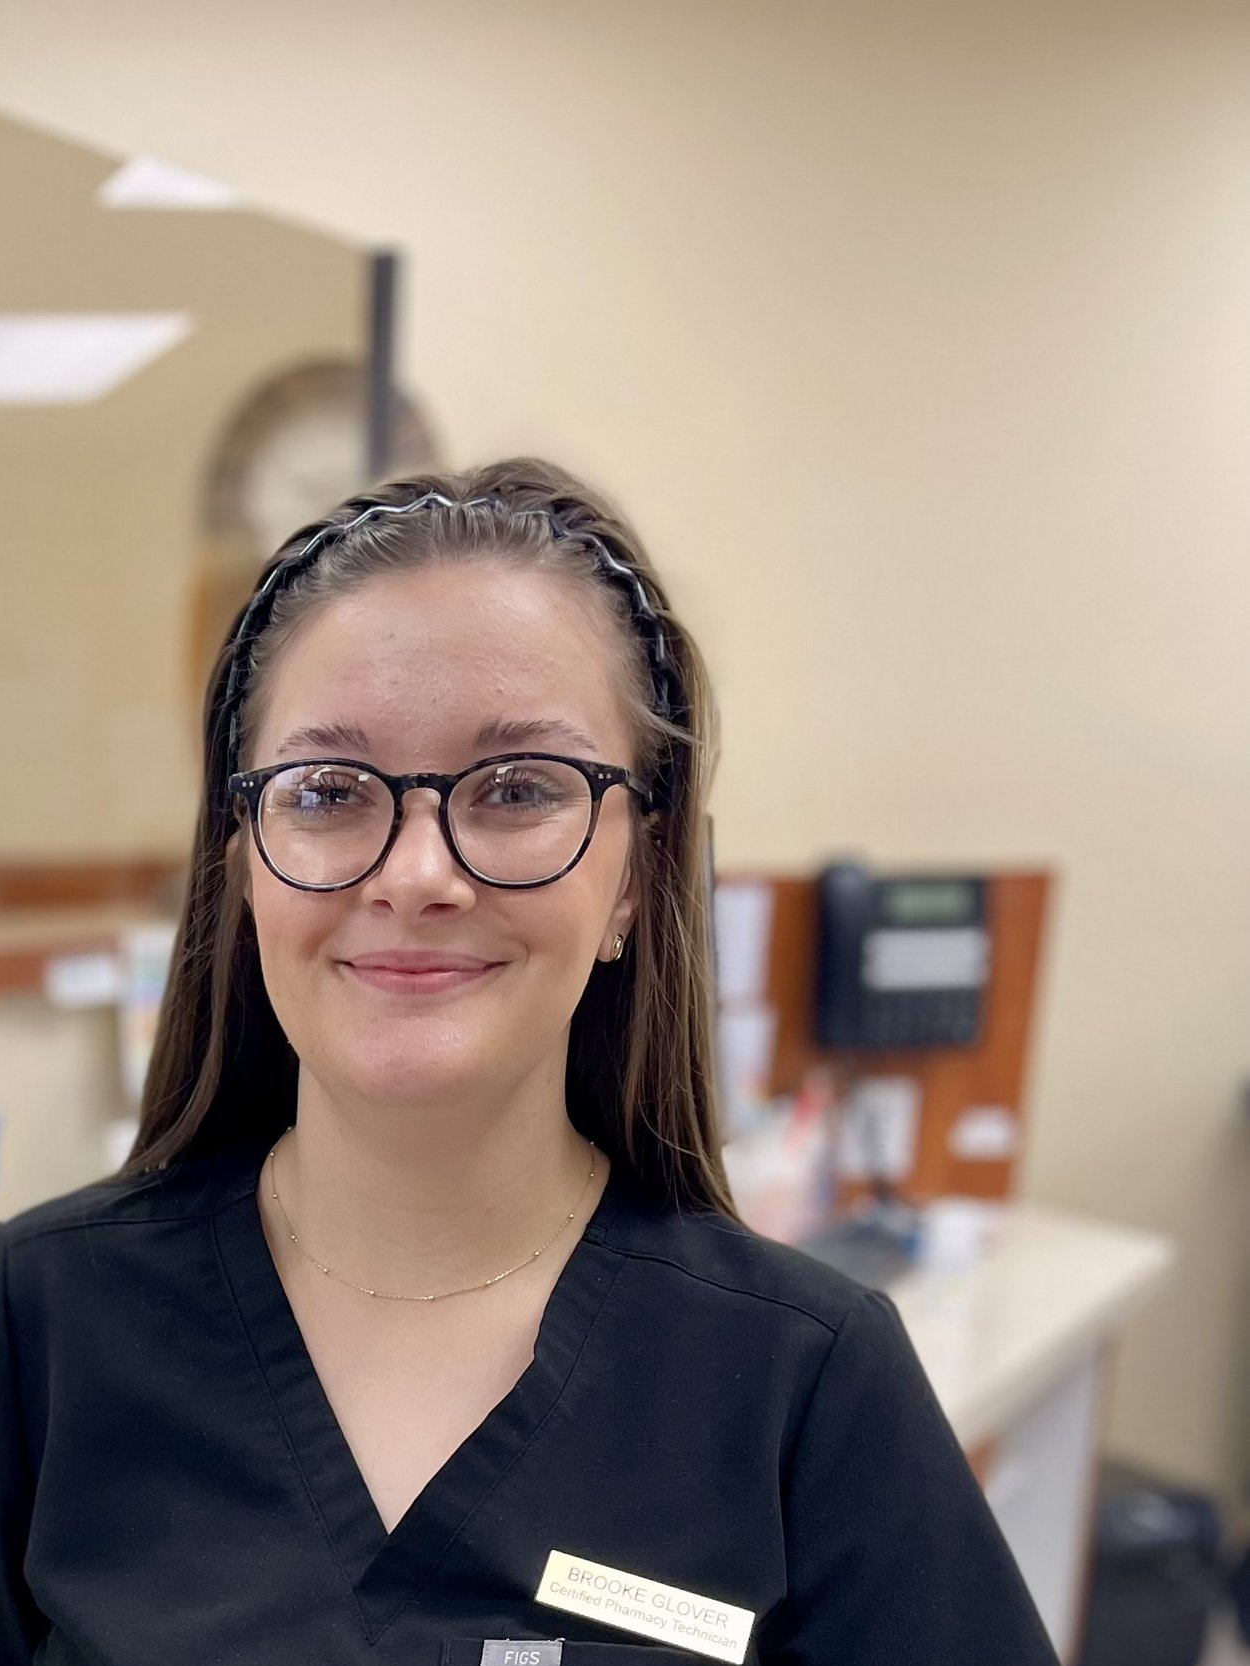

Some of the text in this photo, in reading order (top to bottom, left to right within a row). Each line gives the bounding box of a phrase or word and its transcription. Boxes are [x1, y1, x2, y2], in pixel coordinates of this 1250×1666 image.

[550, 1581, 737, 1649] Certified Pharmacy Technician
[568, 1567, 729, 1629] BROOKE GLOVER
[504, 1651, 541, 1665] FIGS
